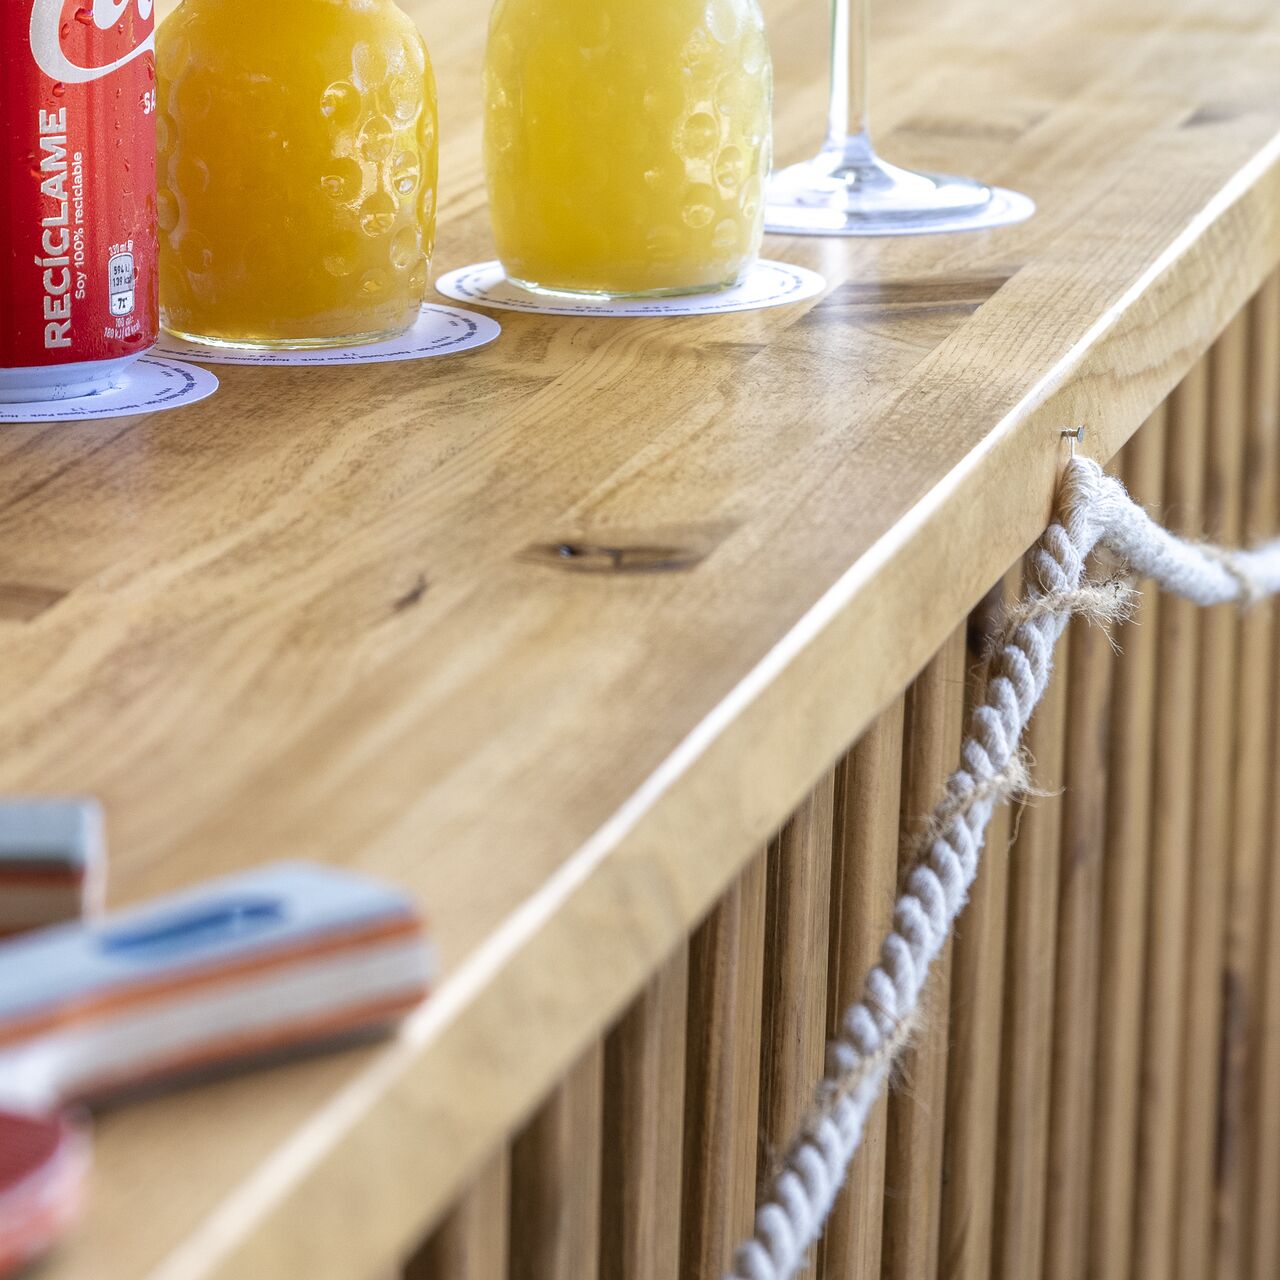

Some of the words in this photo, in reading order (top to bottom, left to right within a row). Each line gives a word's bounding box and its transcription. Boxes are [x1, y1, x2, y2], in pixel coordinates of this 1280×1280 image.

[70, 151, 84, 224] reciclable
[34, 107, 72, 350] RECÍCLAME
[73, 226, 86, 268] 100%
[74, 269, 86, 300] Soy
